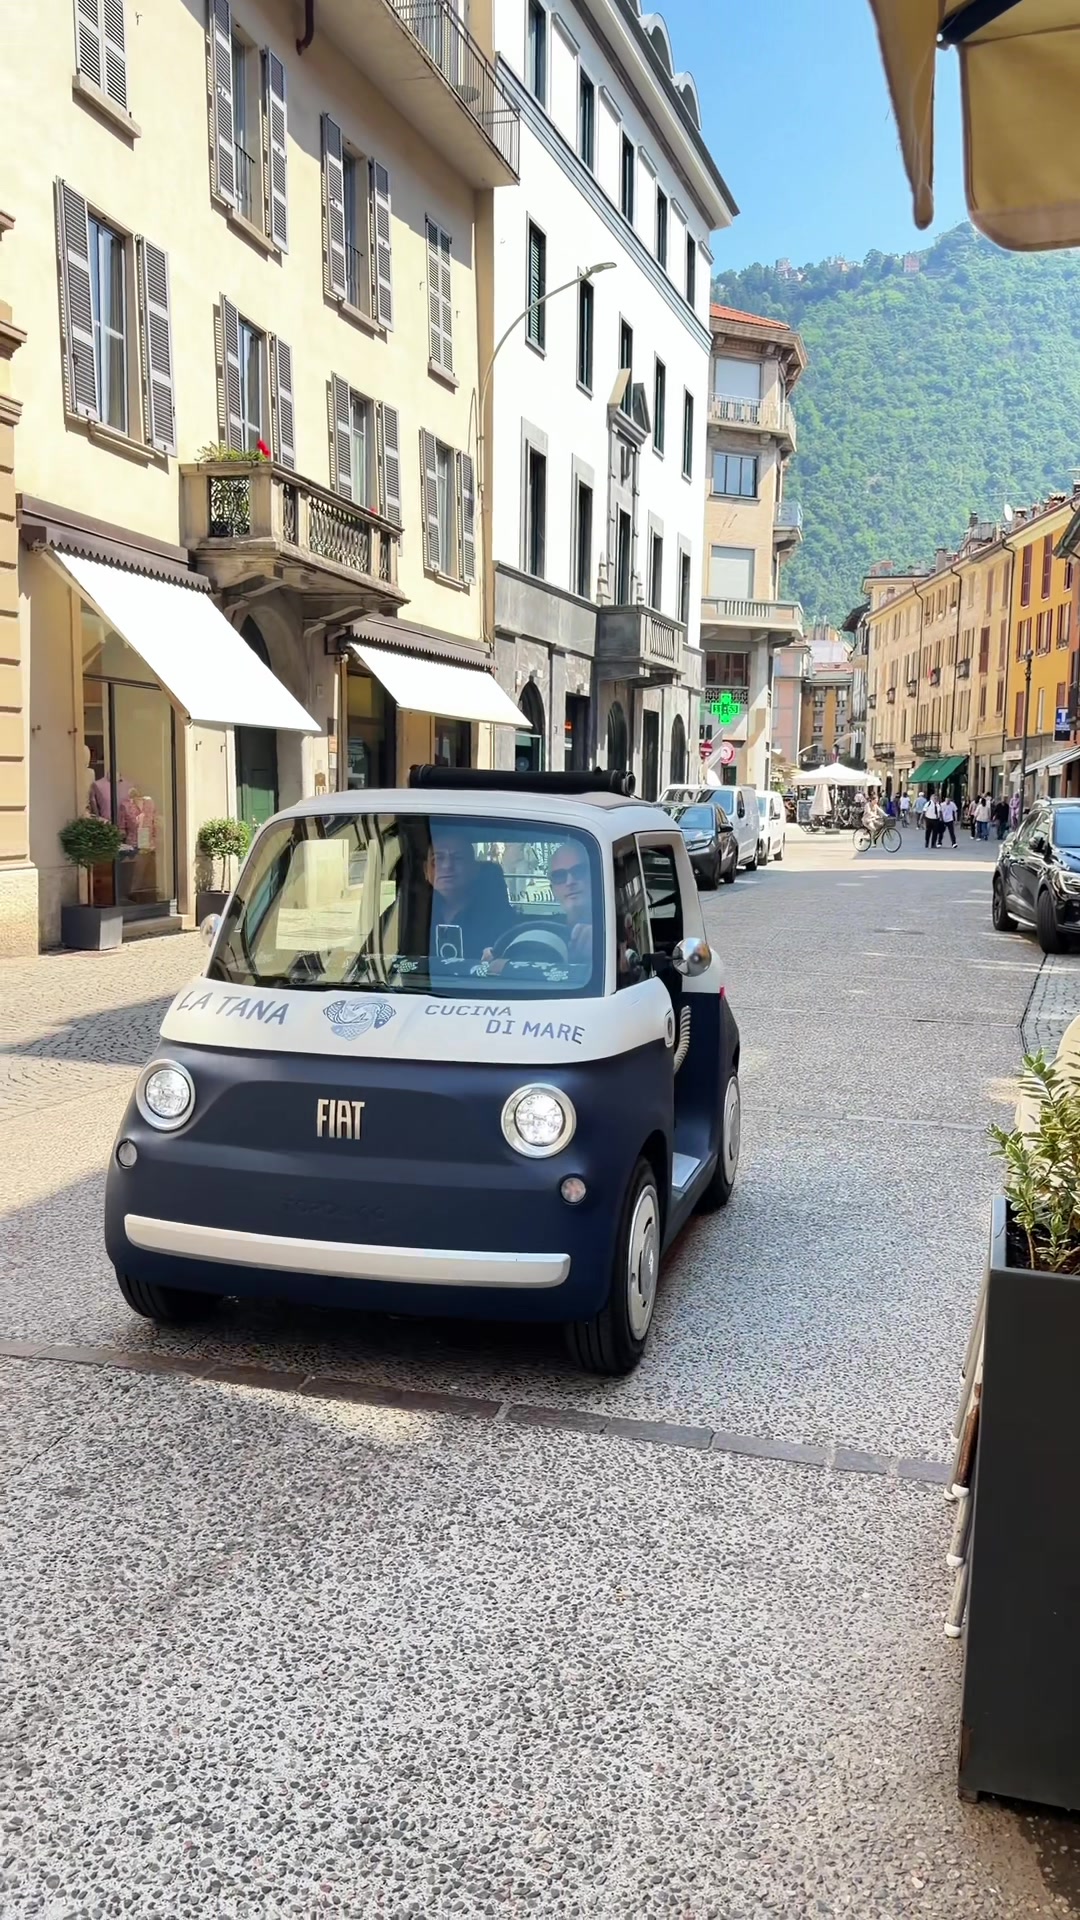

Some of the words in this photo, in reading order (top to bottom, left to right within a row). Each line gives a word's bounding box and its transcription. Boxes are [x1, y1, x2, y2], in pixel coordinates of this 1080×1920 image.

[176, 990, 214, 1012] LA
[215, 995, 290, 1026] TANA
[424, 1004, 513, 1017] CUCINA
[485, 1018, 516, 1036] DI
[521, 1020, 586, 1045] MARE
[316, 1098, 366, 1140] FIAT
